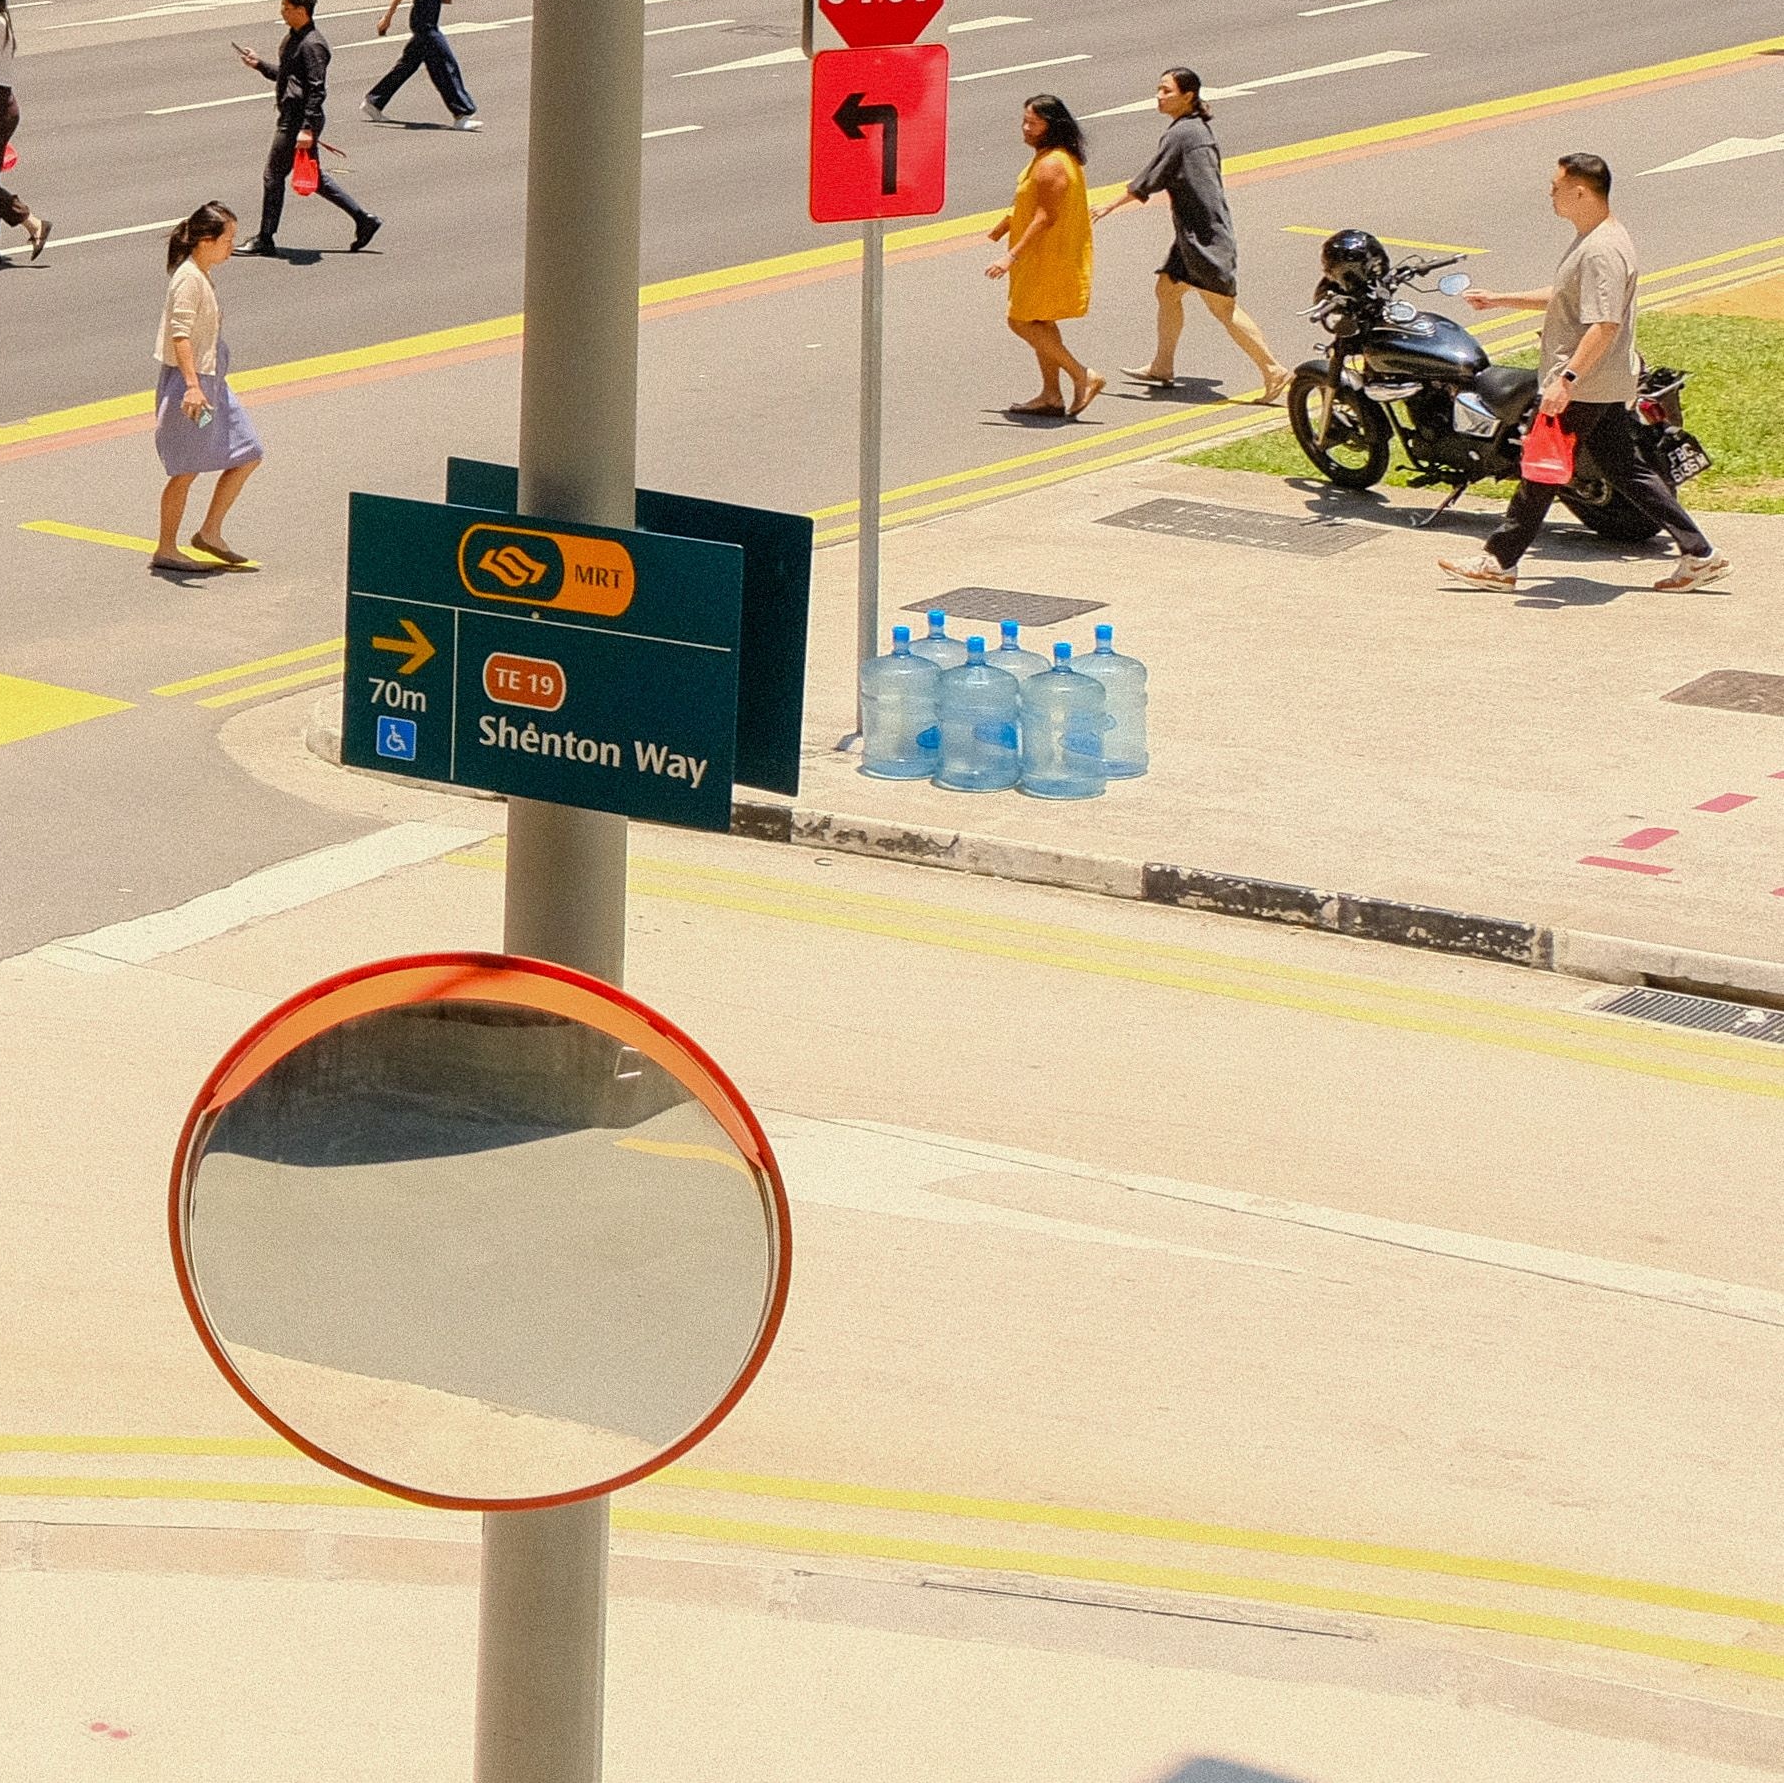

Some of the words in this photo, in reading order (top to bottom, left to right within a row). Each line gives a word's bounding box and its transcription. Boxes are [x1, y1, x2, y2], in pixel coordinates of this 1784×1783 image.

[1667, 442, 1695, 468] FBC
[573, 562, 624, 590] MRT
[368, 677, 428, 714] 70m
[494, 667, 522, 692] TE
[527, 672, 555, 697] 19
[478, 715, 622, 768] Shenton
[634, 739, 709, 790] Way
